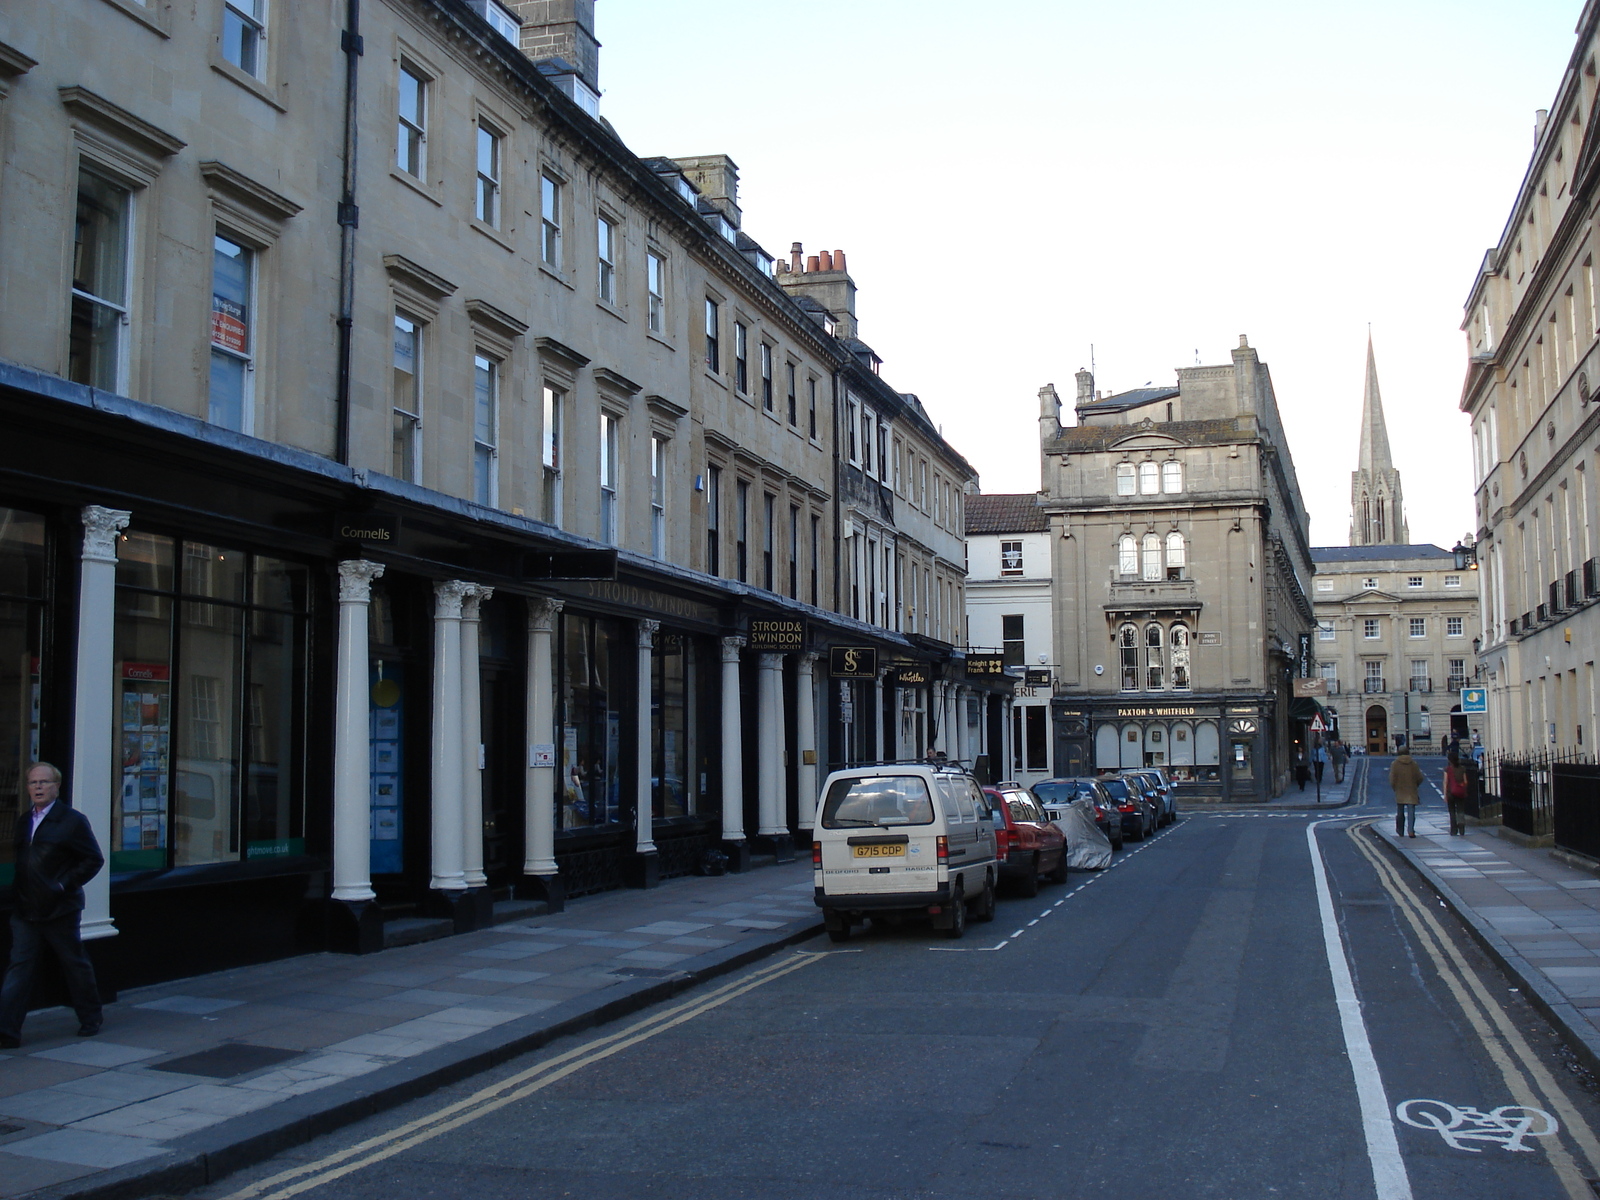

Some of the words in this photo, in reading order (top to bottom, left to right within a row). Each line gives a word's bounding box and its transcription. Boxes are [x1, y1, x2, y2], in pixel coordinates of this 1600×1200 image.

[341, 526, 391, 541] Connells
[588, 581, 639, 605] STROUD
[649, 591, 699, 618] SWINDON
[752, 633, 802, 643] SWINDON
[967, 660, 987, 668] Knight
[128, 668, 153, 679] Connells
[899, 672, 925, 683] Whistles
[1118, 708, 1146, 716] PAXTON
[1156, 707, 1195, 716] WHITFIELD
[857, 846, 879, 856] G715
[882, 845, 902, 855] CDP
